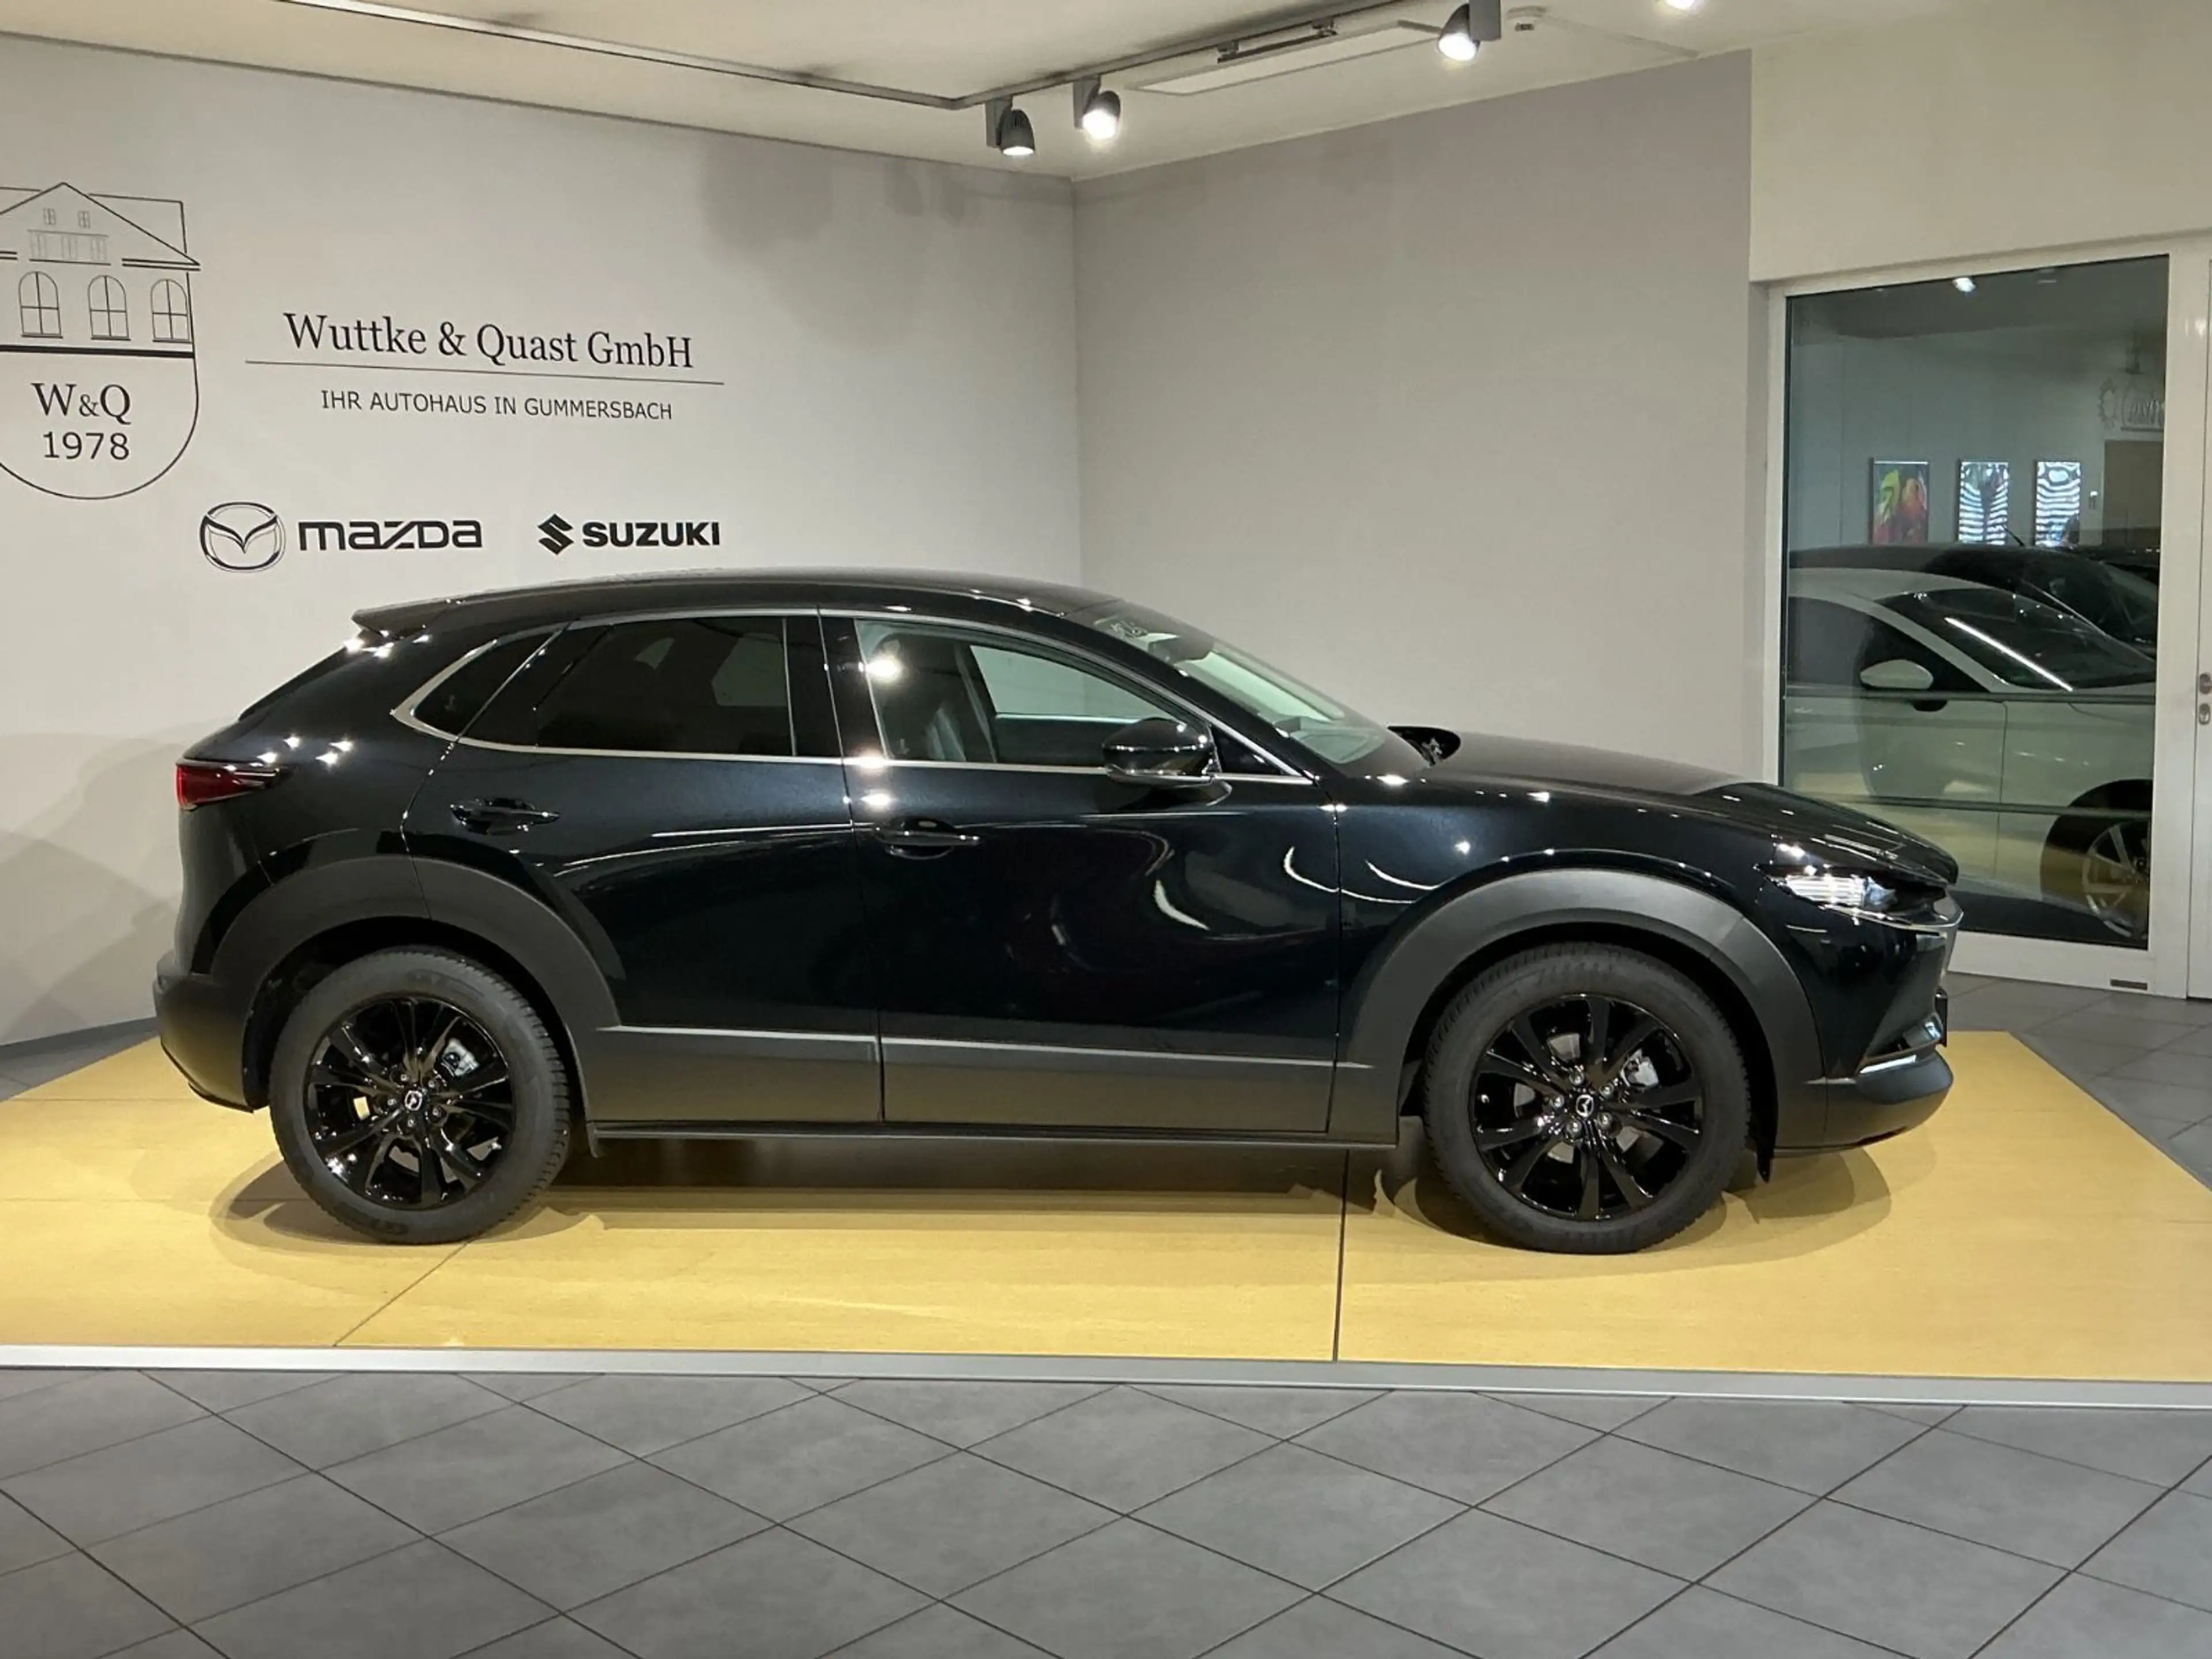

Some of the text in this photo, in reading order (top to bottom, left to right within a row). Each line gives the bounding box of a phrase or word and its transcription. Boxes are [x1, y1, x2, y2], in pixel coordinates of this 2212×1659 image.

[283, 312, 694, 368] Wuttke & Quast GmbH
[31, 382, 131, 425] W&Q
[321, 390, 672, 420] IHR AUTOHAUS IN GUMMERSBACH
[43, 431, 130, 460] 1978
[582, 521, 720, 547] SUZUKI
